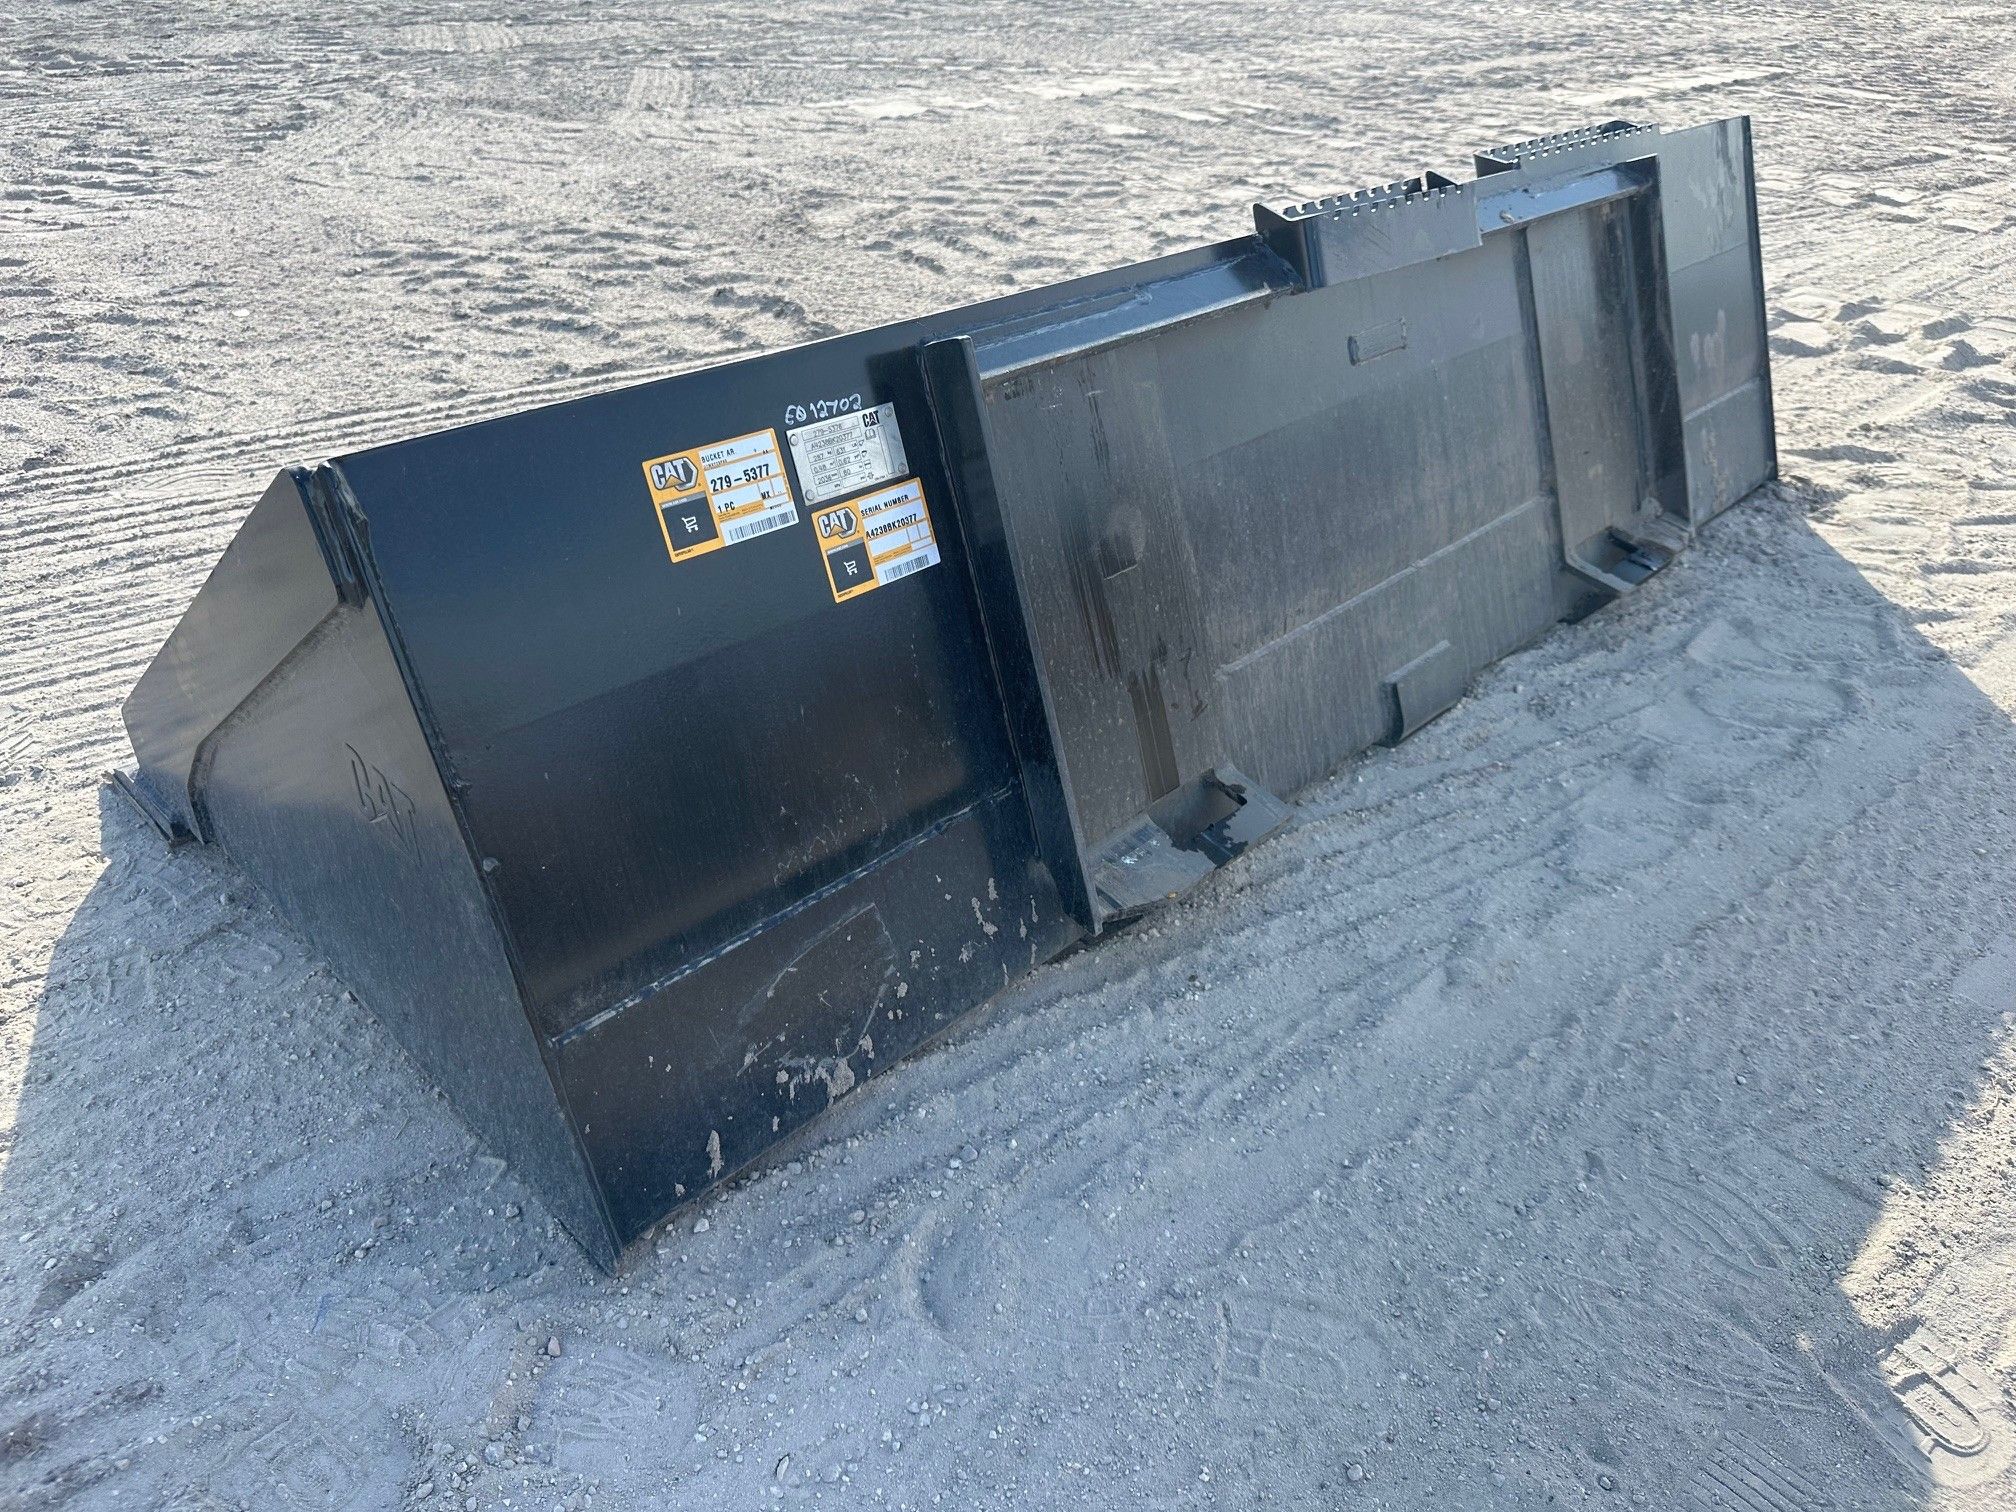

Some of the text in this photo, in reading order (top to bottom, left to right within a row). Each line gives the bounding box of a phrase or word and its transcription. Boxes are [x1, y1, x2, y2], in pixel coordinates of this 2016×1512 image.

[863, 410, 880, 427] CAT
[701, 450, 725, 463] BUCKET
[651, 457, 686, 490] CAT
[711, 464, 770, 492] 279-5377
[725, 501, 735, 512] PC
[761, 491, 771, 500] MX
[861, 494, 909, 516] SERIAL NUMBER
[819, 509, 848, 538] CAT
[866, 513, 917, 539] A4238BK20377
